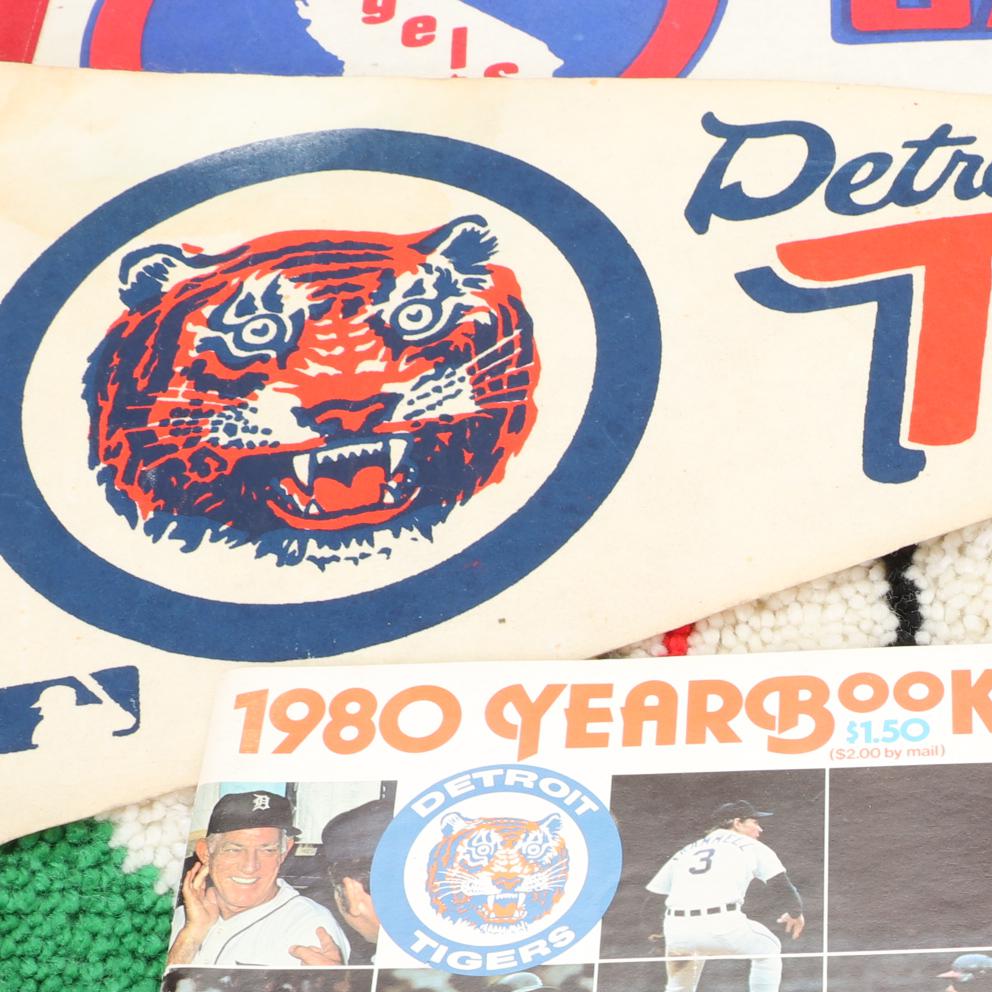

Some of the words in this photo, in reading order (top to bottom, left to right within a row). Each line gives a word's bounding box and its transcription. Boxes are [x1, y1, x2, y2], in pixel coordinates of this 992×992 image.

[233, 684, 462, 756] 1980
[846, 717, 931, 744] $1.50
[829, 747, 881, 761] ($2.00
[884, 747, 902, 760] by
[906, 744, 946, 758] mail)
[410, 767, 600, 818] DETROIT
[688, 848, 716, 875] 3
[410, 924, 577, 972] TIGERS
